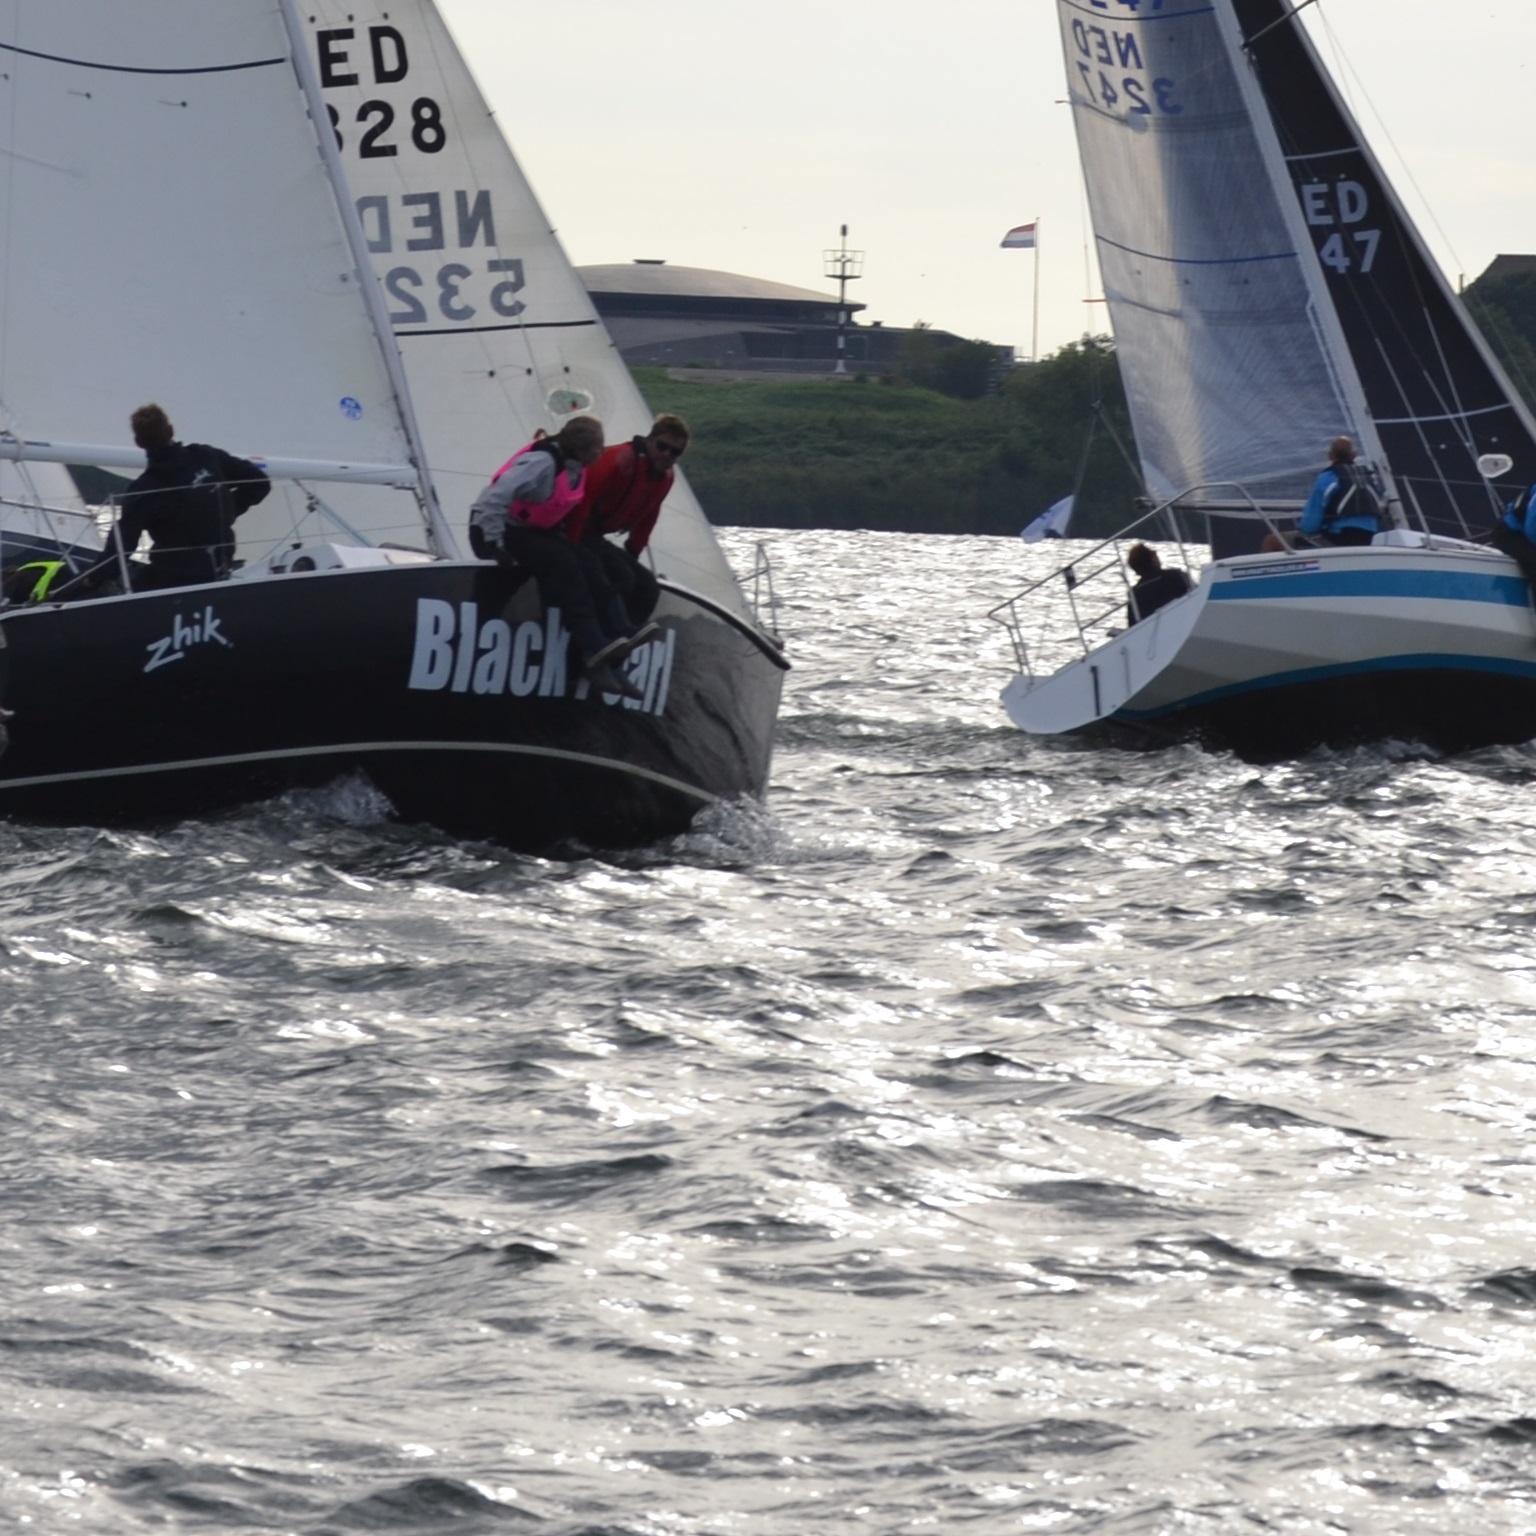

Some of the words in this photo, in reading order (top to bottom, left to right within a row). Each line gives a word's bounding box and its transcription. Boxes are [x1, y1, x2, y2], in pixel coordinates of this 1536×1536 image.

[316, 25, 409, 89] ED
[1302, 181, 1368, 225] ED
[1320, 230, 1381, 274] 47
[408, 598, 571, 697] Black
[574, 628, 676, 716] arl
